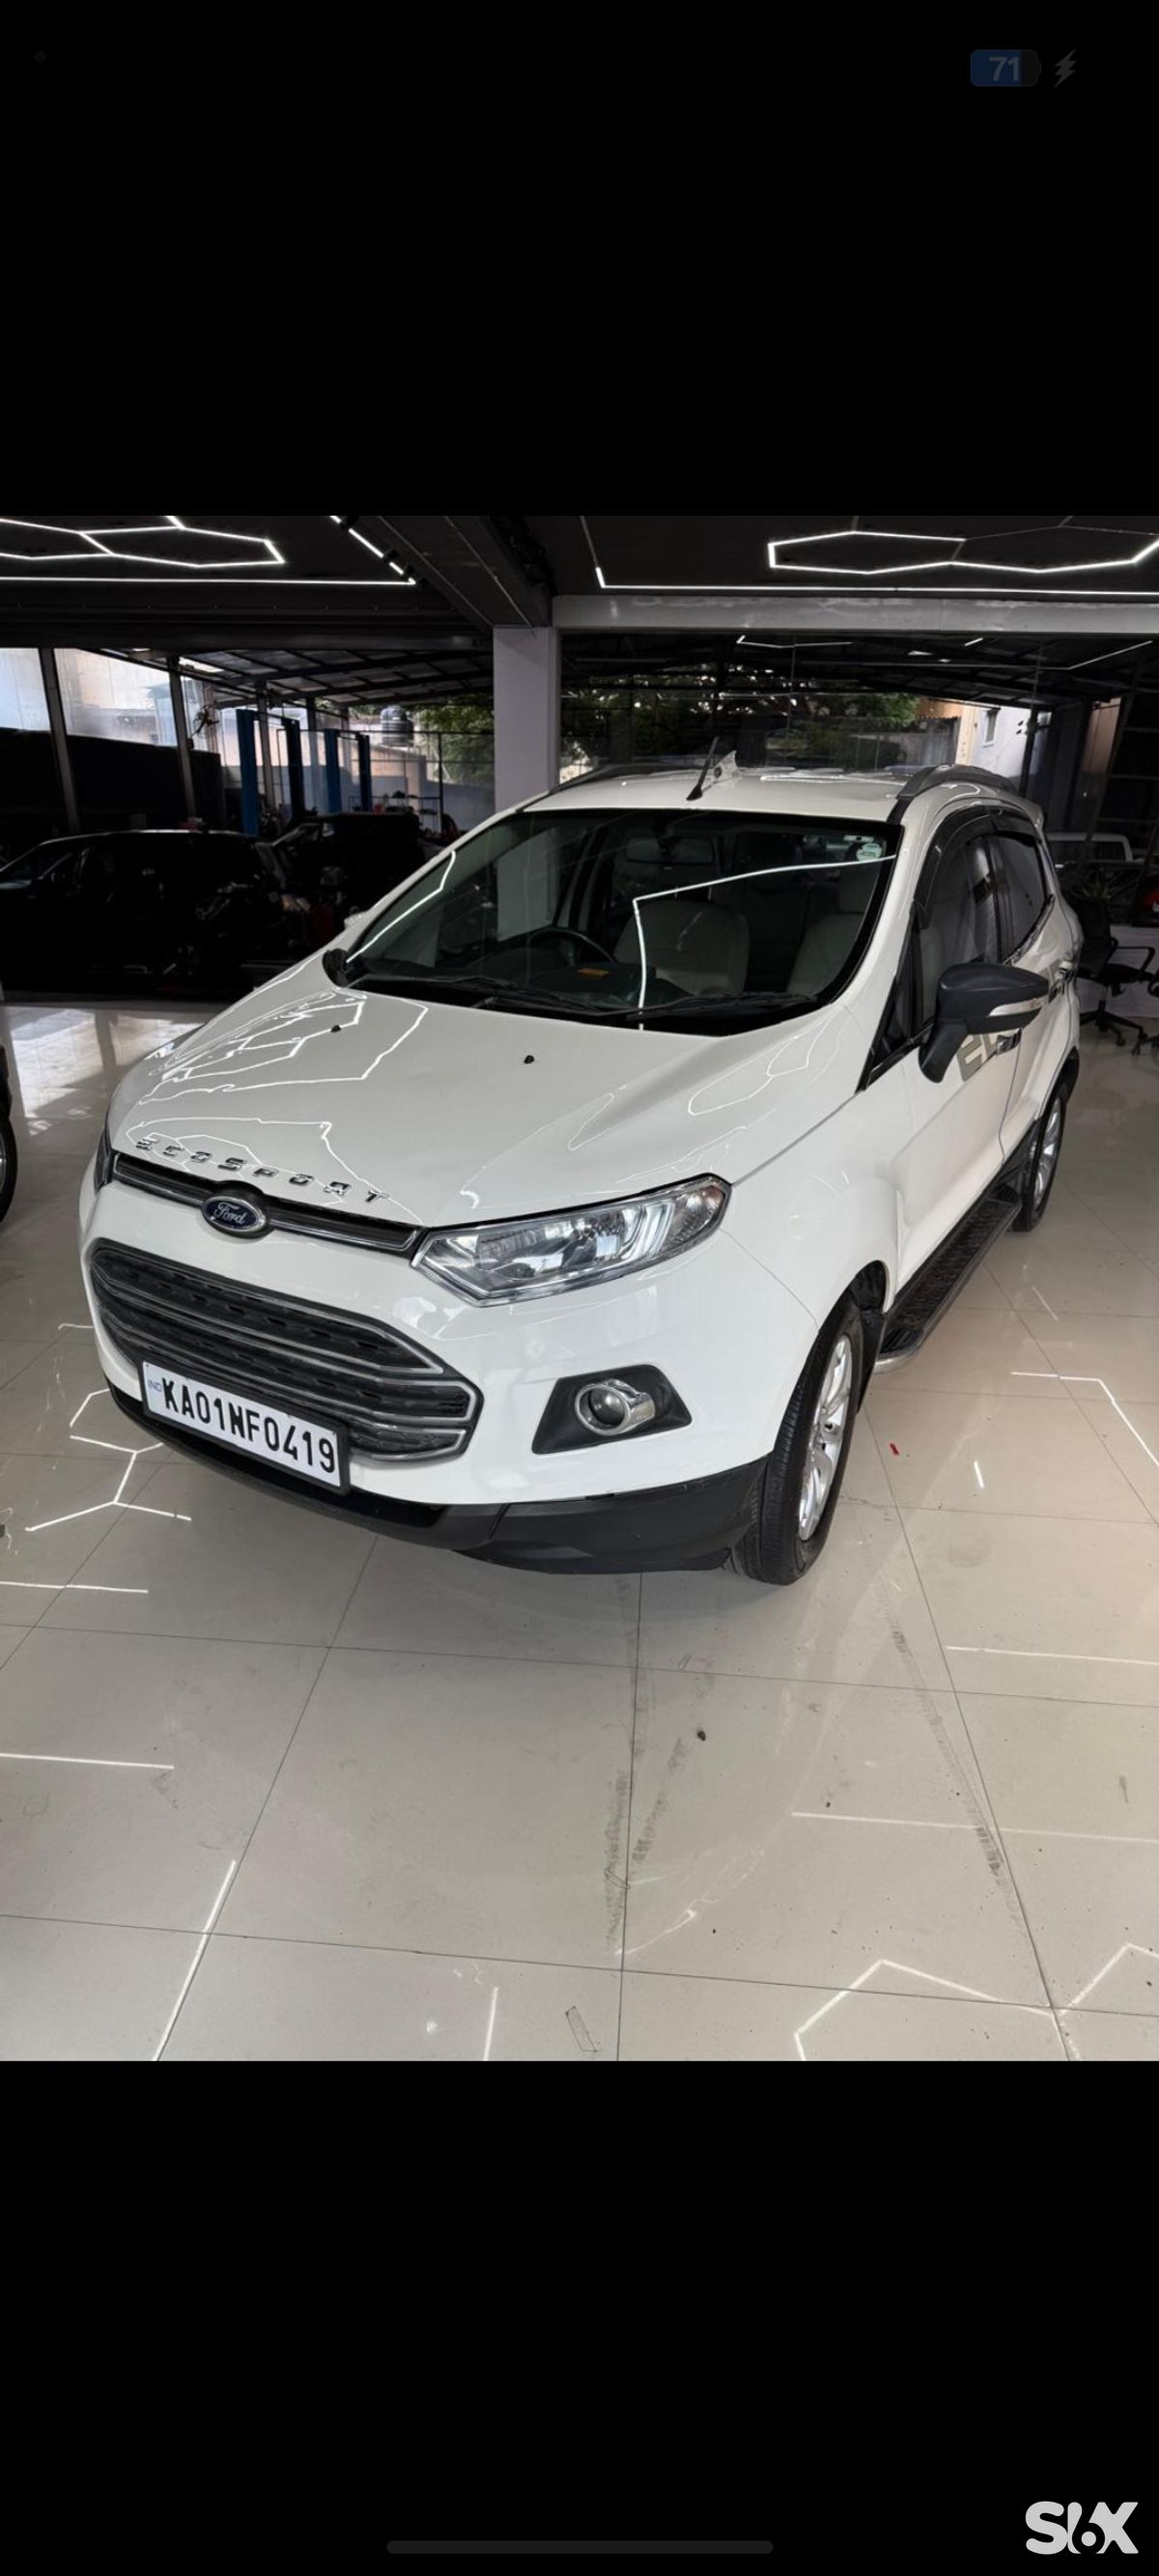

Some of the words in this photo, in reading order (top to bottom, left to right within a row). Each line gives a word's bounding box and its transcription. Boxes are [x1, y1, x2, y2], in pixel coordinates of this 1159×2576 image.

[136, 1136, 388, 1203] ECOSPORT
[213, 1202, 246, 1225] Ford
[161, 1377, 336, 1474] KA01NF0419
